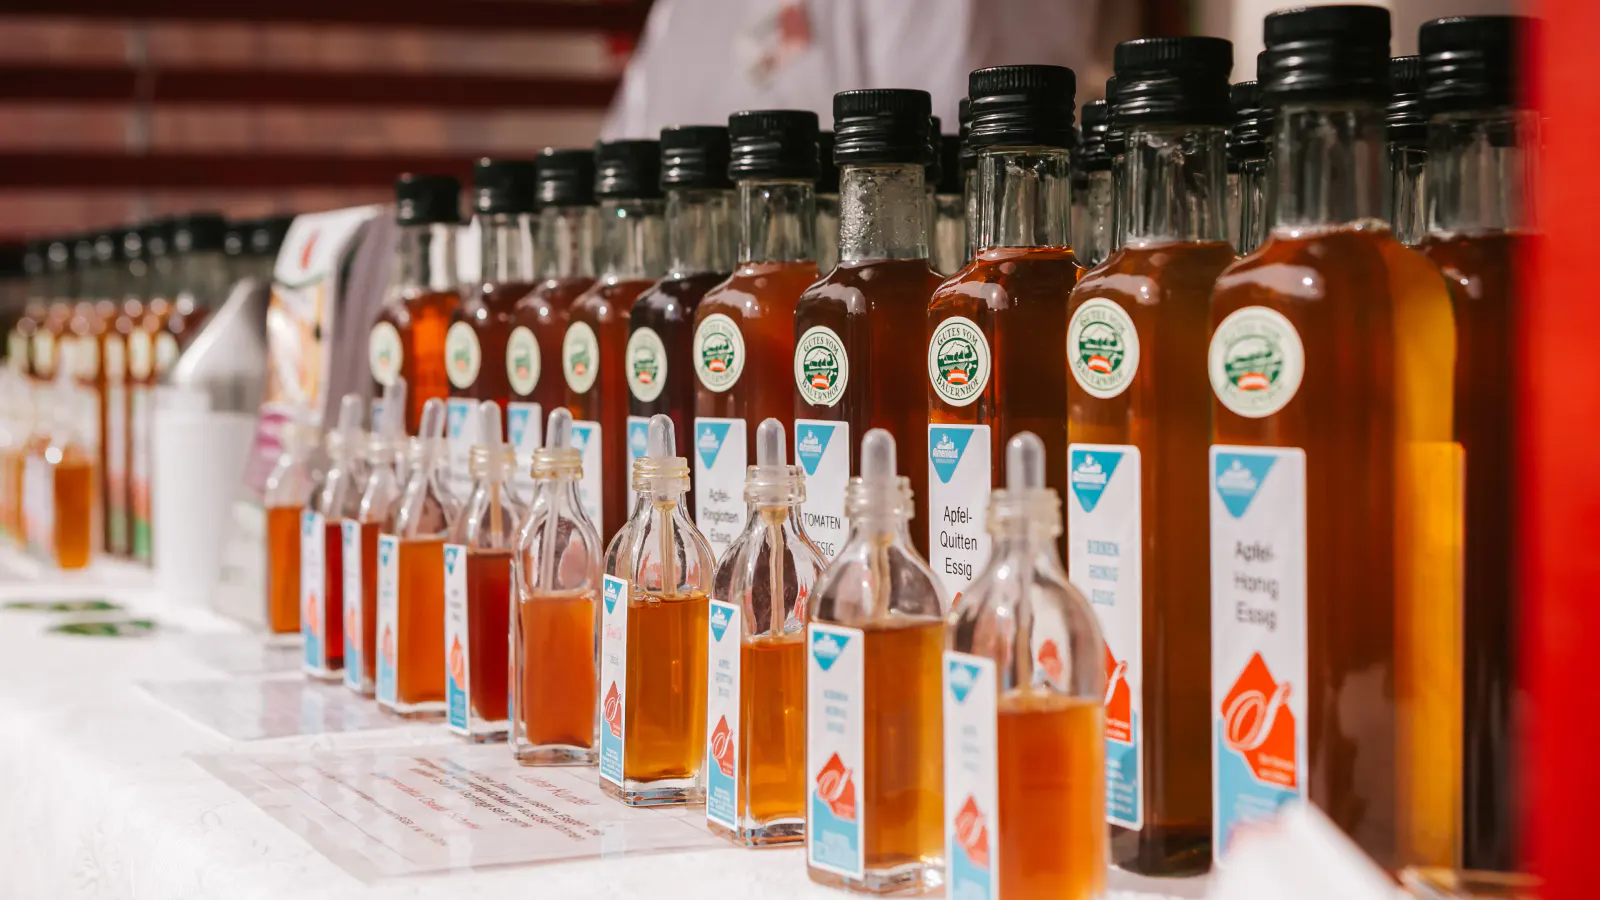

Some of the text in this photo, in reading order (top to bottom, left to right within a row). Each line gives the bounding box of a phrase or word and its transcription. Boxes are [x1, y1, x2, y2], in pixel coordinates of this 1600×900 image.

[803, 336, 839, 355] GUTES VOM
[936, 327, 978, 346] GUTES VOM
[802, 378, 840, 401] BAUERNHOF
[936, 373, 979, 397] BAUERNHOF
[803, 512, 841, 530] TOMATEN
[943, 505, 973, 527] Apfel-
[940, 530, 978, 551] Quitten
[945, 557, 972, 581] Essig
